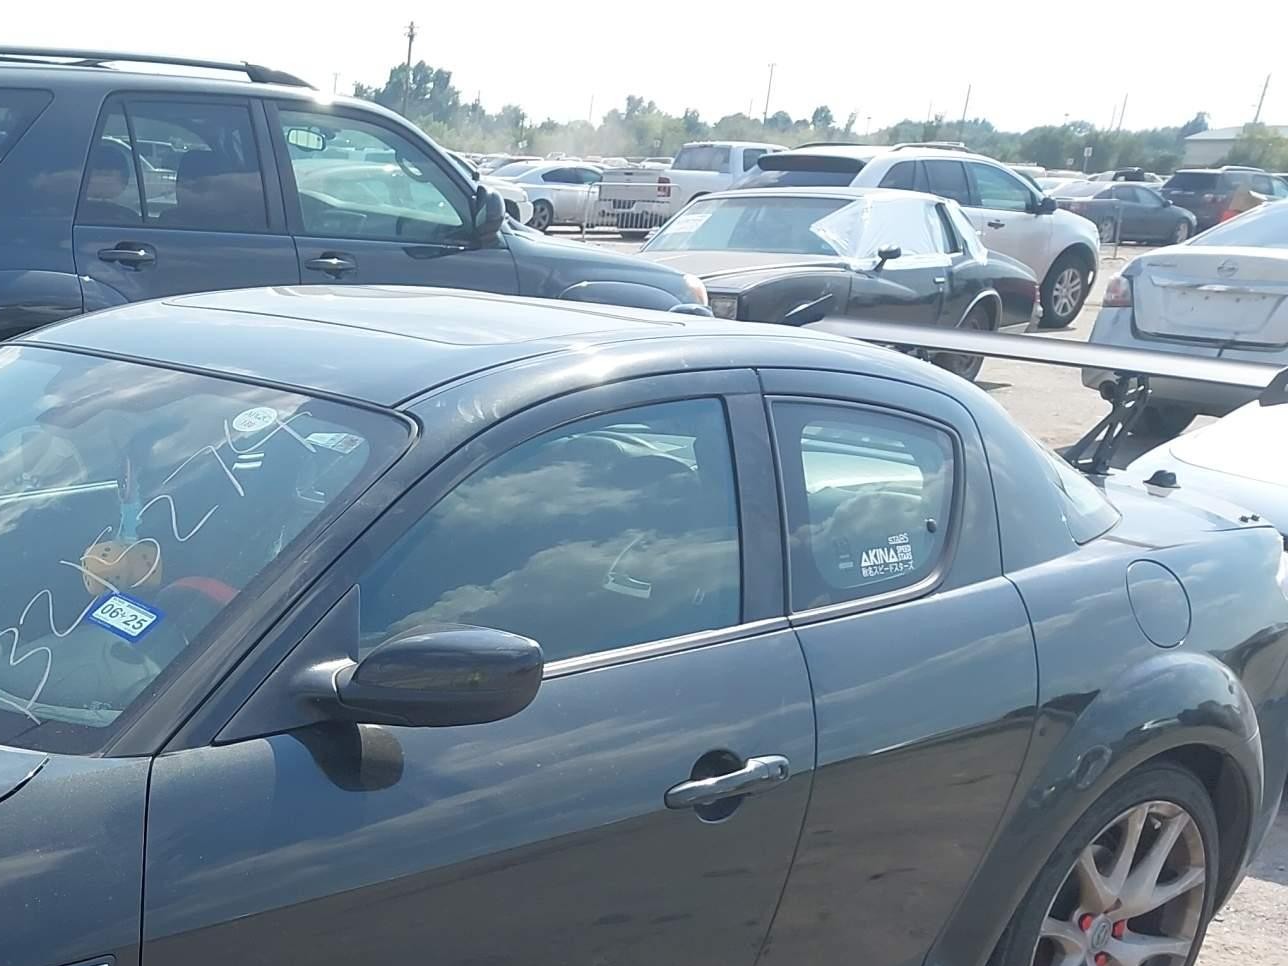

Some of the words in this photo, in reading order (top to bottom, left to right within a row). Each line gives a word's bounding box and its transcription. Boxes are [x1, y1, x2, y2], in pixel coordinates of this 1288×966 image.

[861, 547, 898, 567] AKINA
[100, 603, 123, 618] 06
[122, 614, 148, 630] 25
